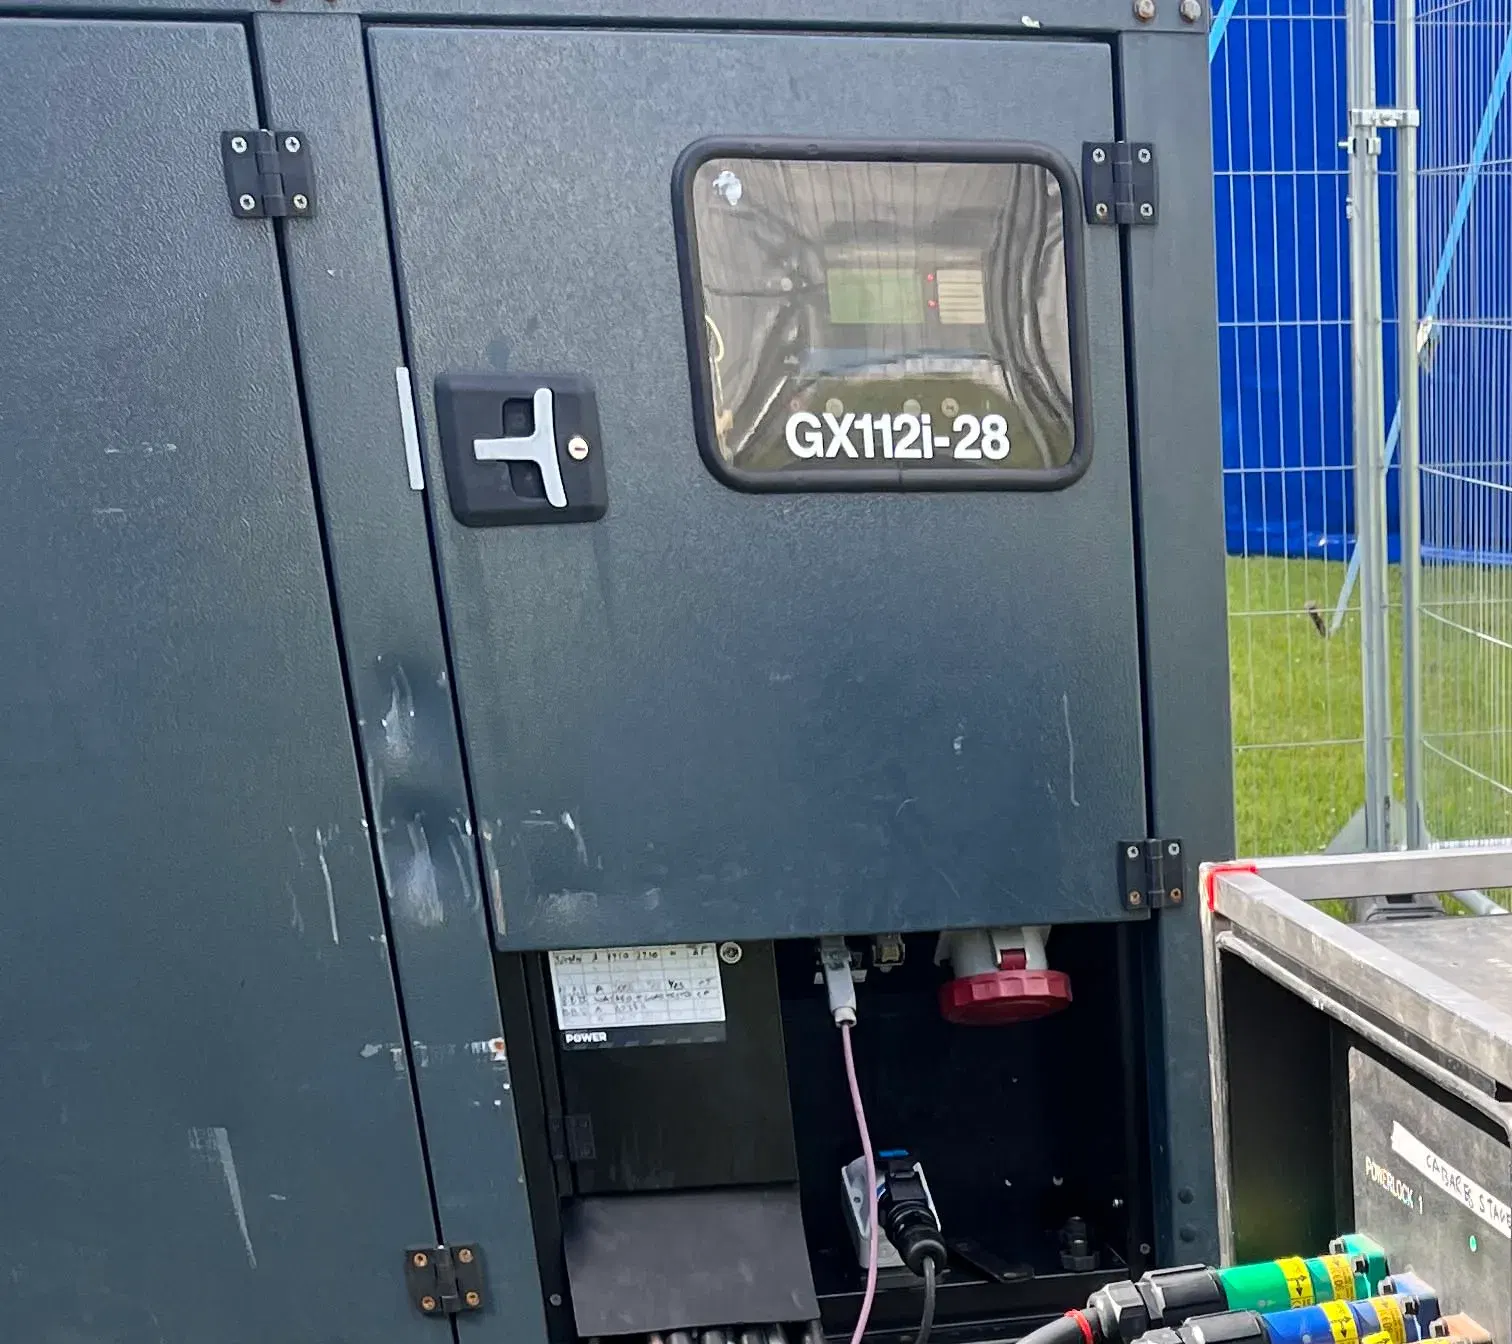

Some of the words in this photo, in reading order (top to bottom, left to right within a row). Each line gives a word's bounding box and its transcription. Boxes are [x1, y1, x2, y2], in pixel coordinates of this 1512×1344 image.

[785, 411, 1010, 460] GX112i-28
[565, 1032, 607, 1043] POWER
[1365, 1156, 1414, 1209] POWERLOCK
[1418, 1195, 1423, 1215] 1
